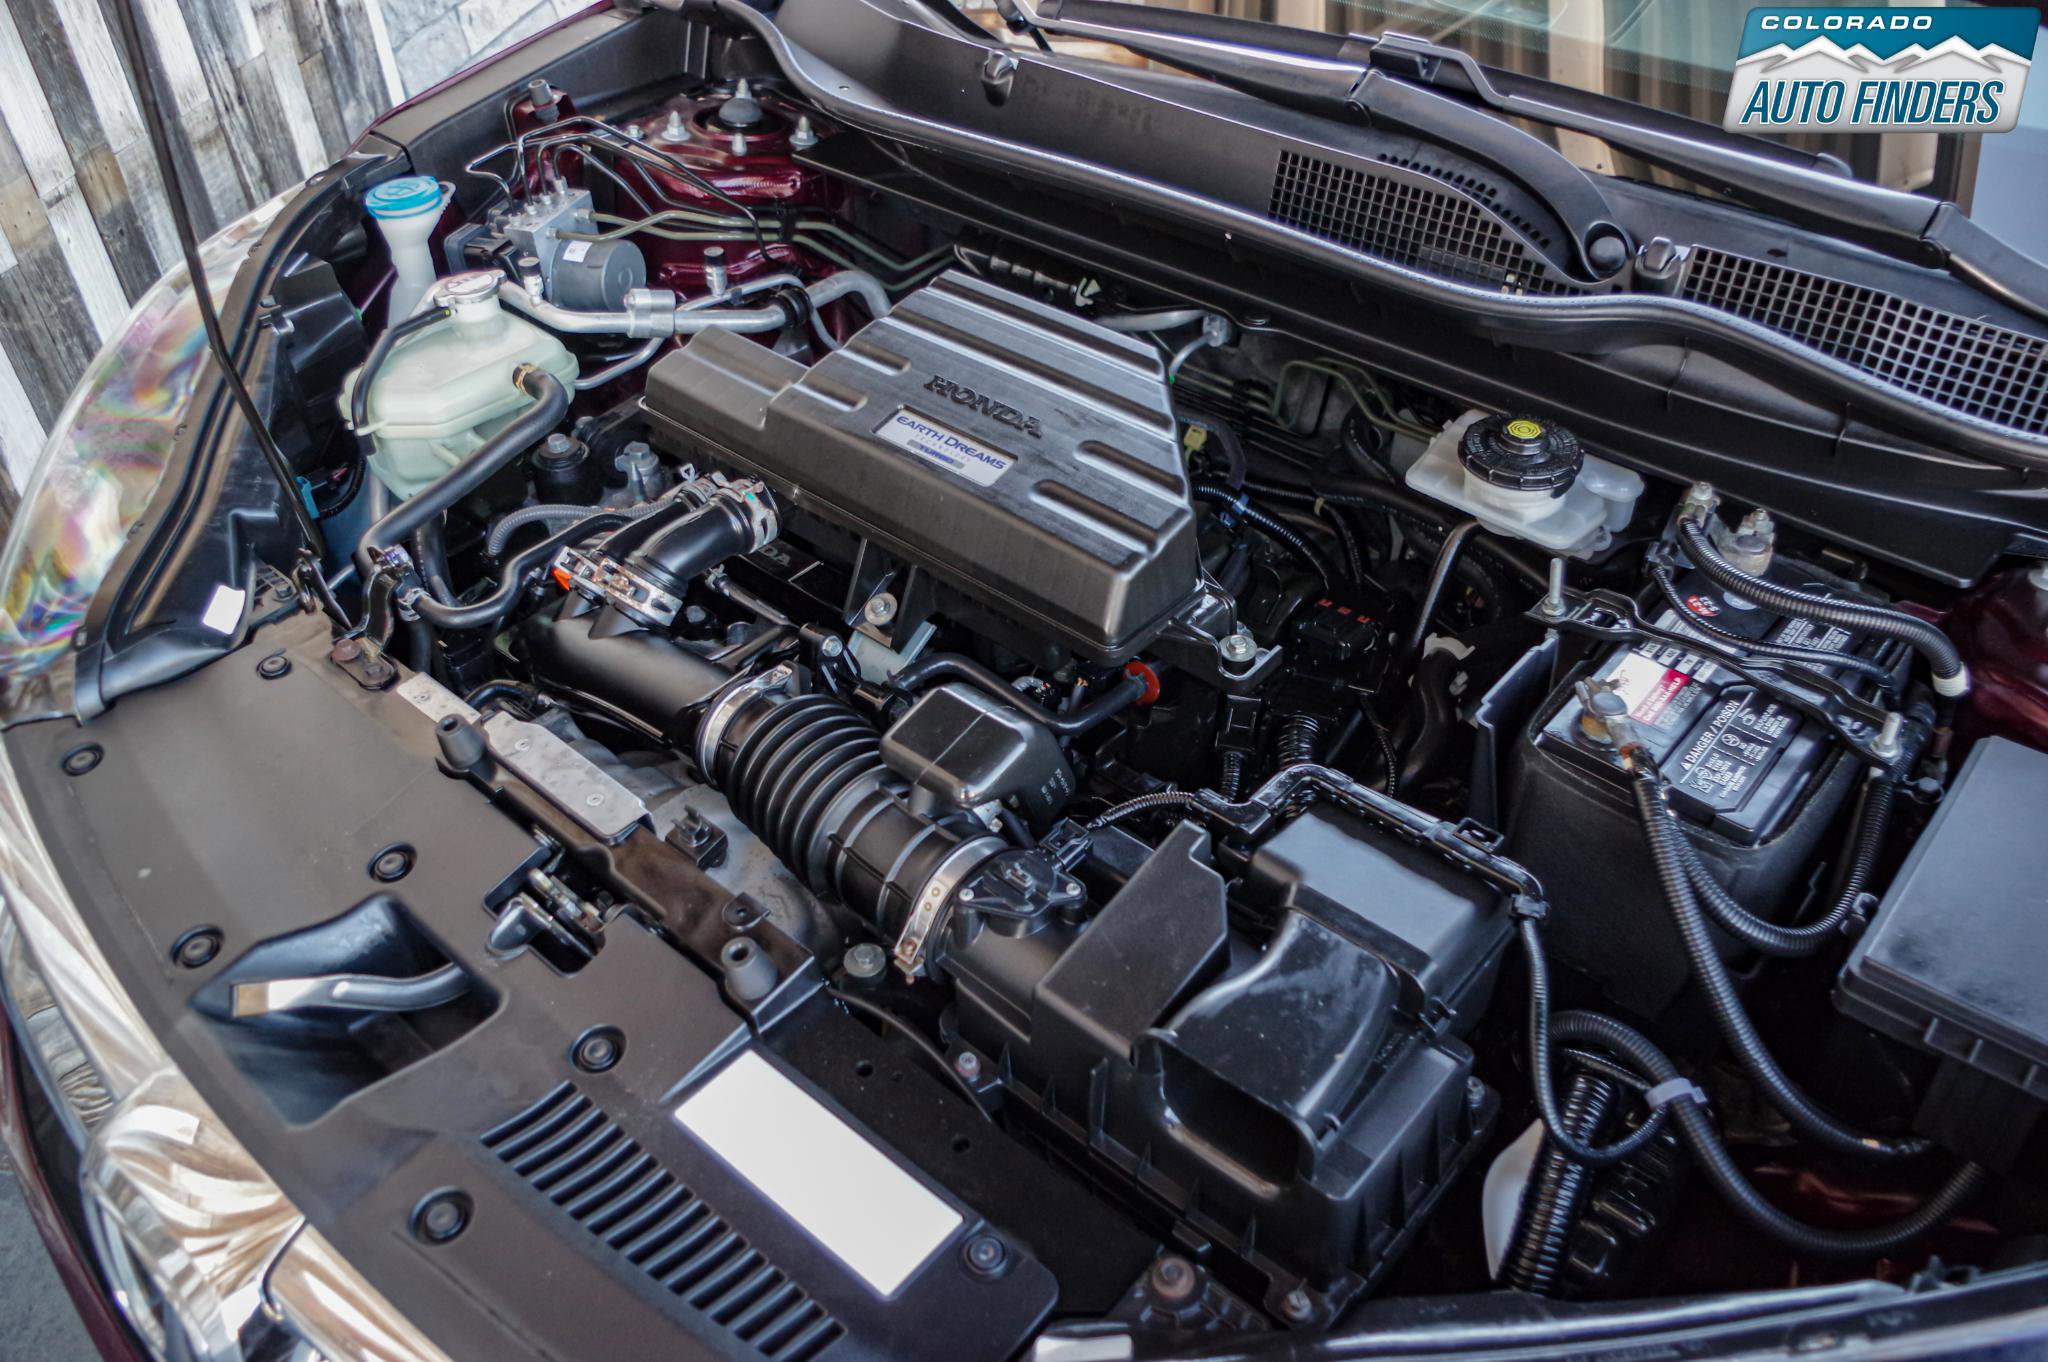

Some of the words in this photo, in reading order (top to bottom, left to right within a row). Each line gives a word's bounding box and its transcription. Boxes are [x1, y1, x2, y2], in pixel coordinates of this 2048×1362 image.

[923, 374, 1042, 439] HONDA
[896, 415, 945, 442] EARTH
[944, 436, 1007, 470] DREAMS
[919, 443, 955, 464] TURBO
[1684, 731, 1715, 764] DANGER
[1712, 699, 1740, 728] POISON
